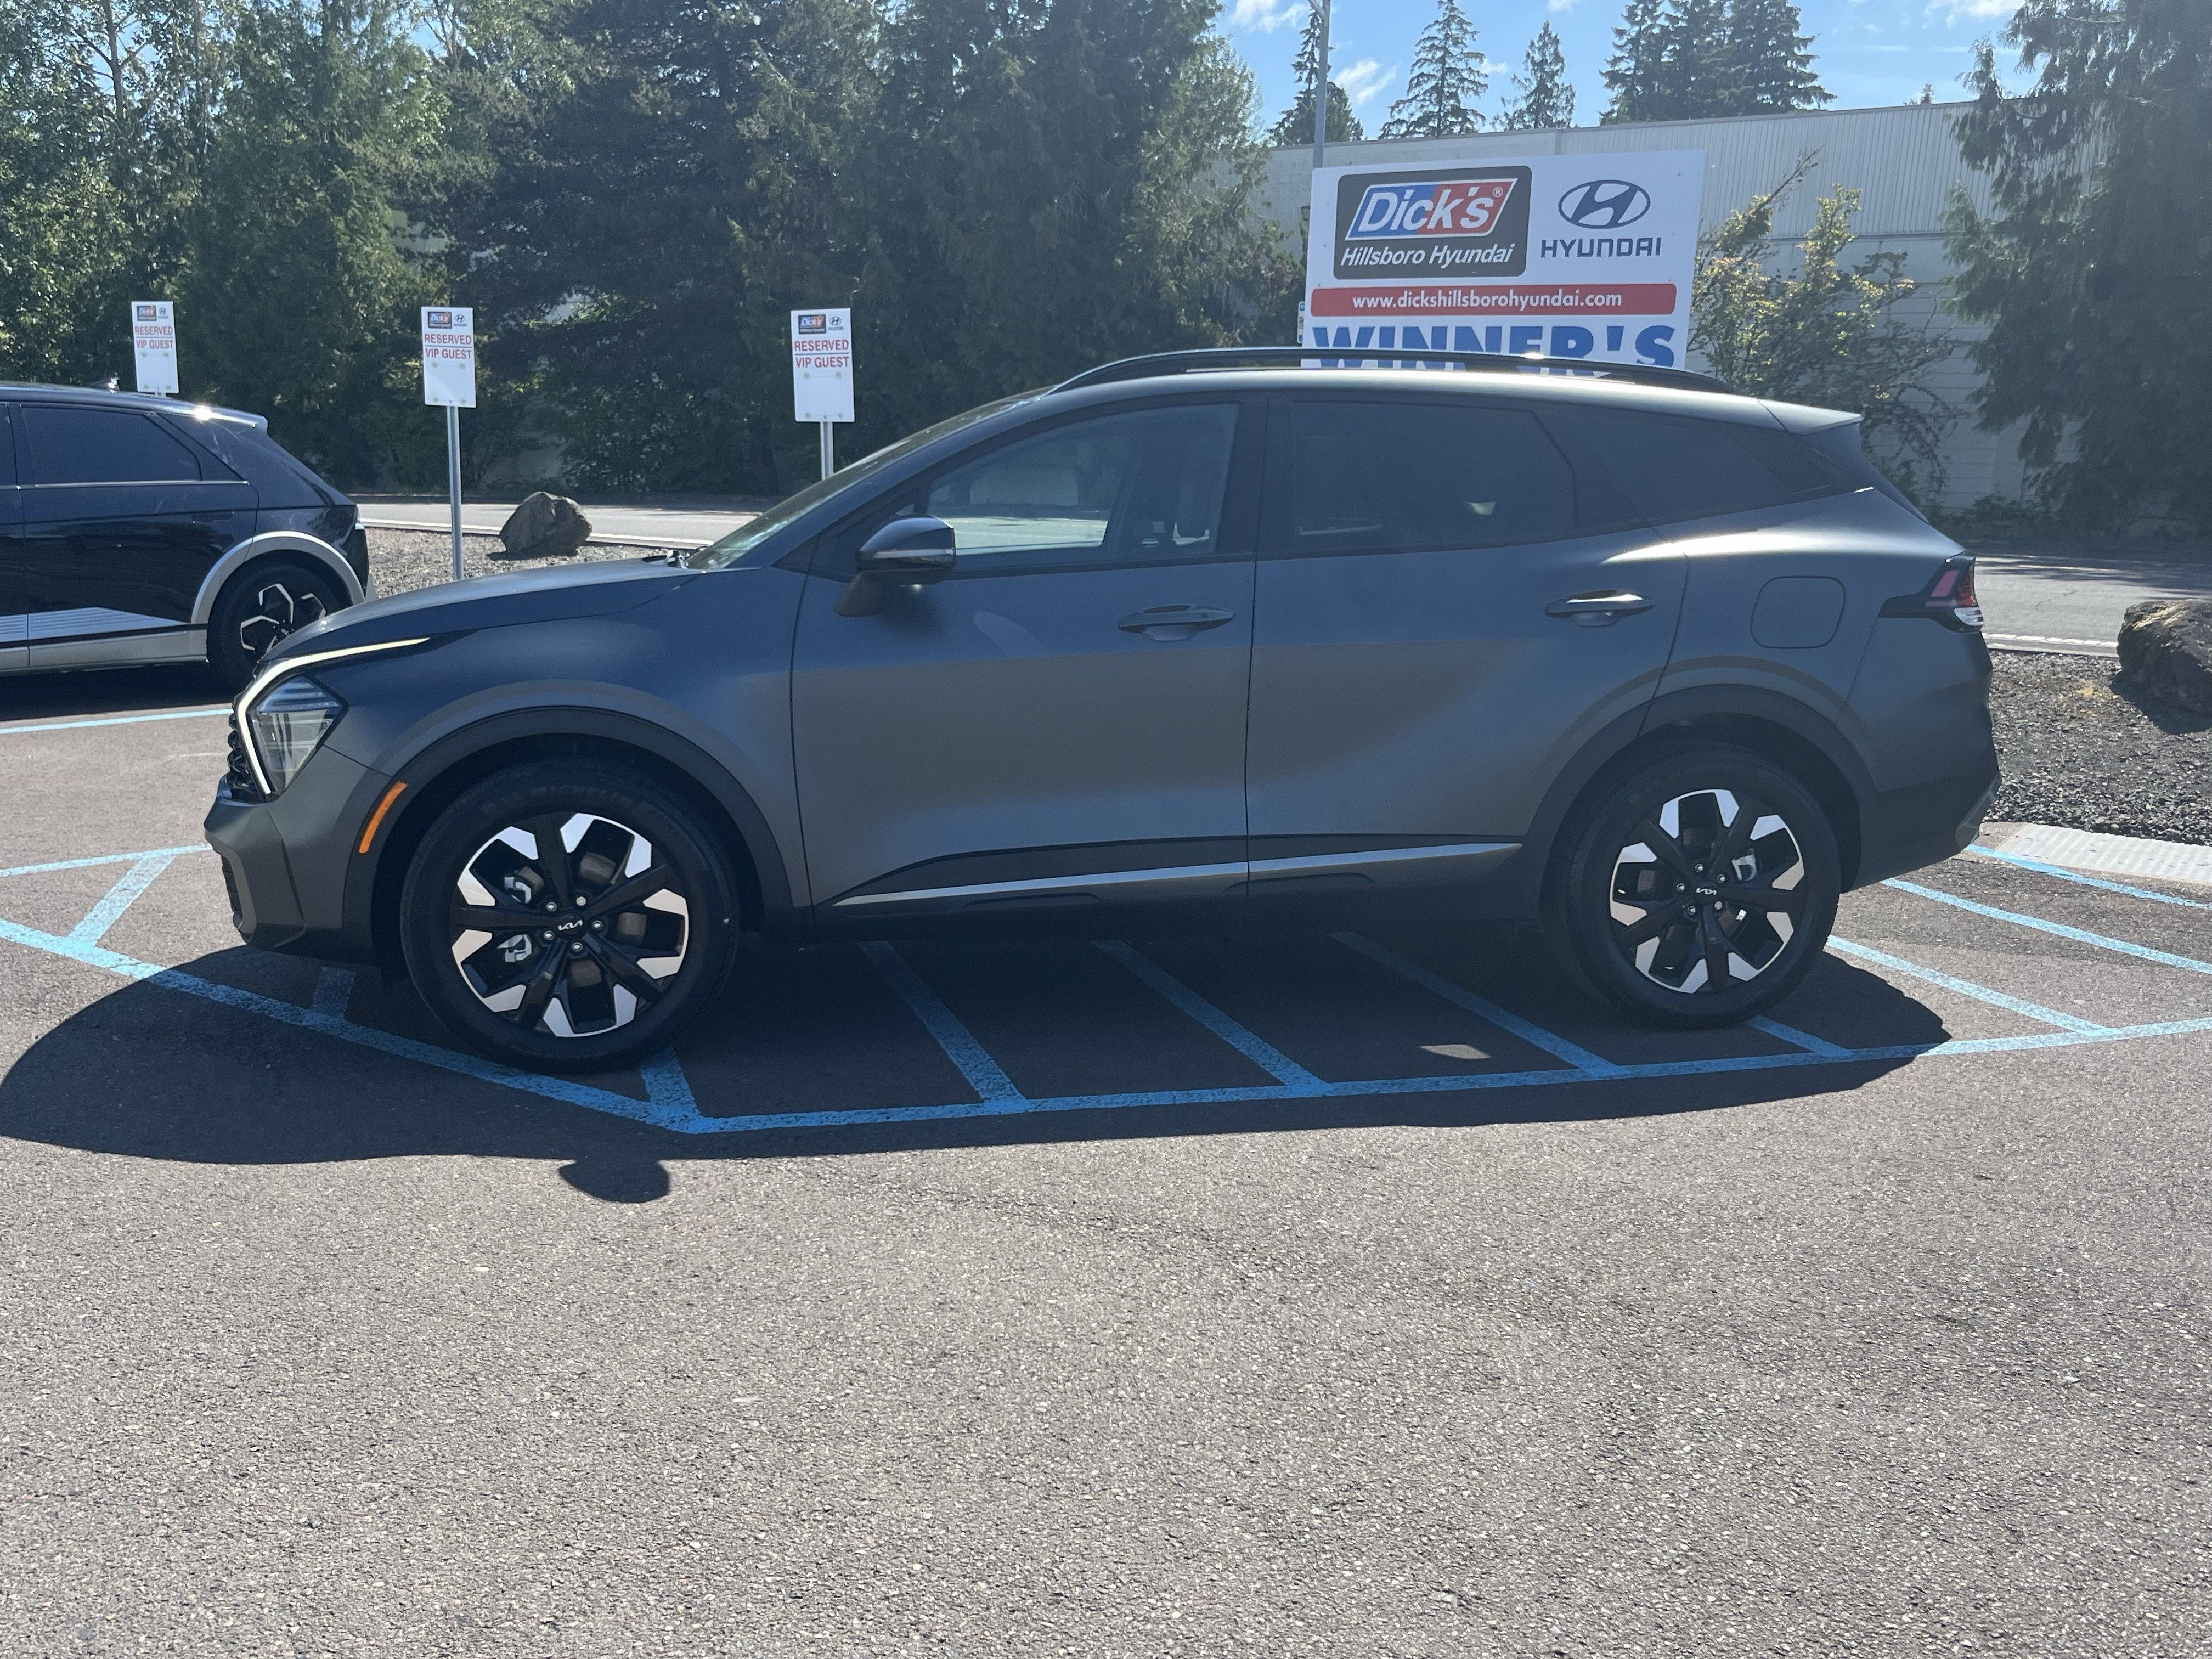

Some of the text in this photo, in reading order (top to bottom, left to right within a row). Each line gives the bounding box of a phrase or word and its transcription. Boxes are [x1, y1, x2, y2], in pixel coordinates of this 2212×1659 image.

[1358, 186, 1494, 232] Dick's
[1541, 237, 1662, 258] HYUNDAI
[1340, 244, 1516, 269] Hillsboro Hyundai
[1352, 290, 1622, 311] www.dickshillsborohyundai.com
[134, 325, 173, 336] RESERVED
[136, 339, 173, 349] VIP GUEST
[424, 334, 472, 345] RESERVED
[794, 340, 849, 352] RESERVED
[425, 348, 472, 359] VIP GUEST
[795, 356, 849, 368] VIP GUEST
